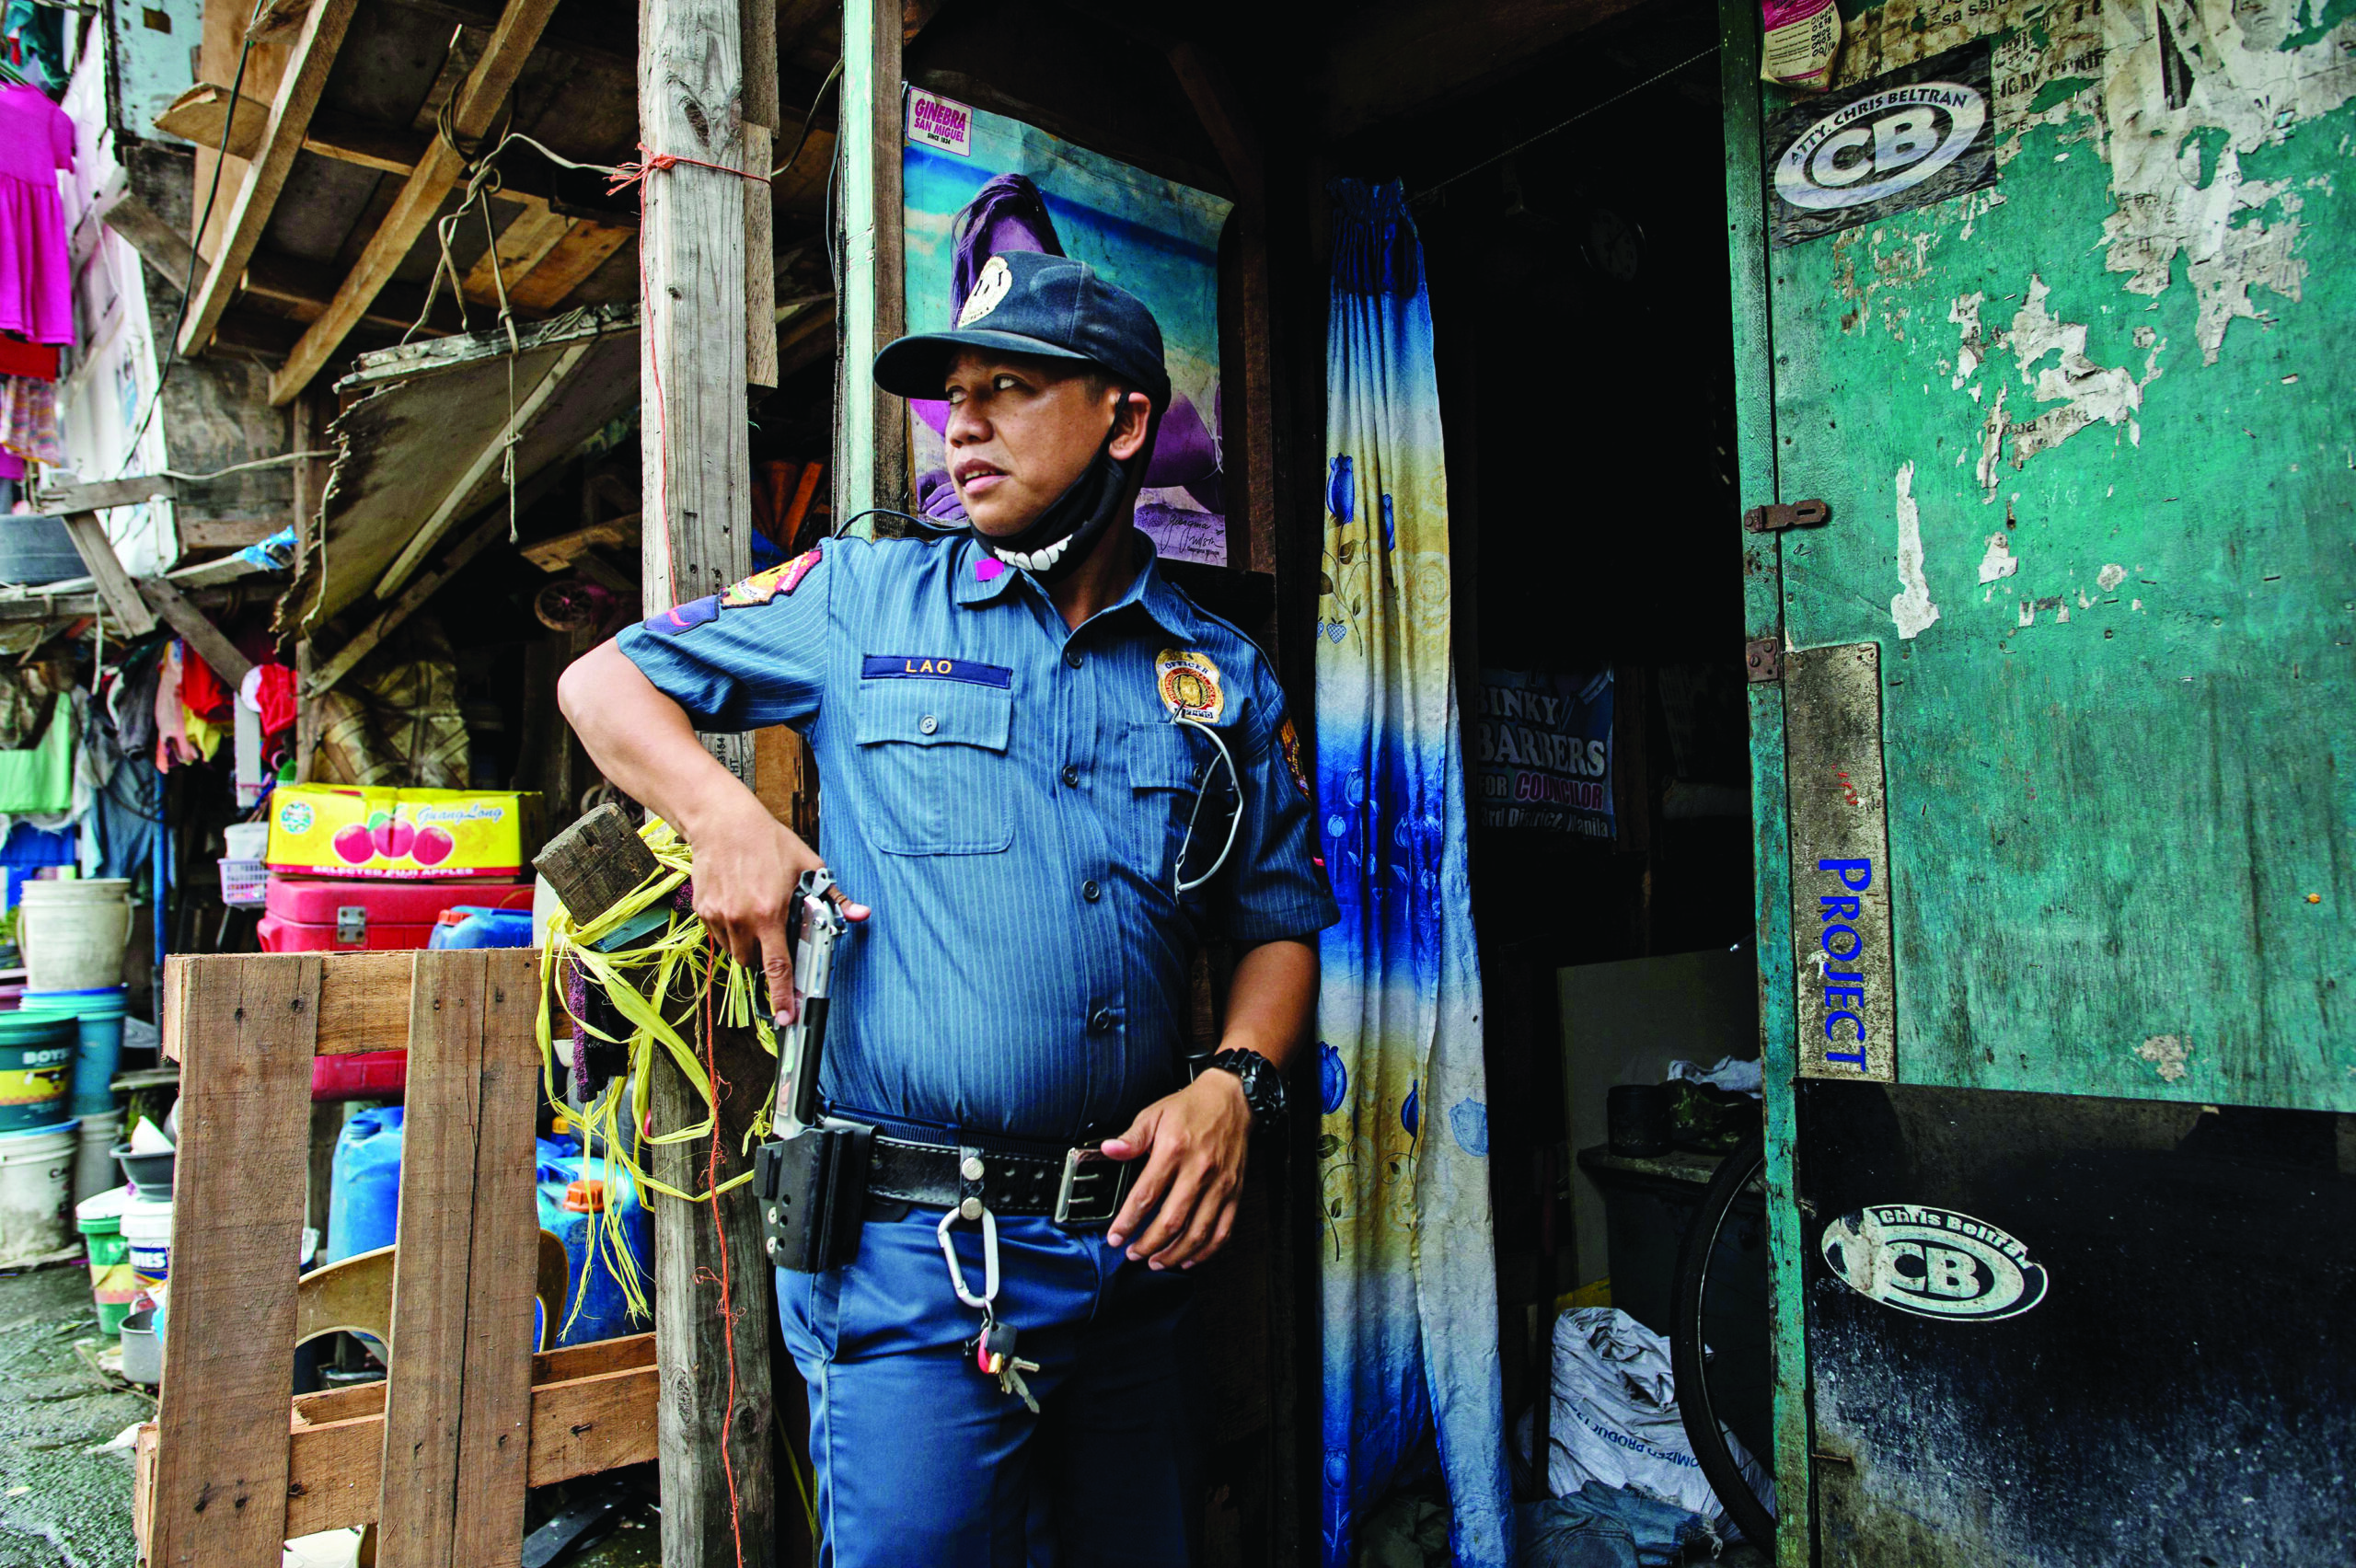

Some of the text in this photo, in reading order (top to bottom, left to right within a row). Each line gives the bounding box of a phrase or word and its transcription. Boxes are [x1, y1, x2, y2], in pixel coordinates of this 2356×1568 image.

[914, 98, 967, 132] GINEBRA
[914, 117, 964, 143] SAN MIGUEL
[1790, 88, 1968, 166] ATTY. CHRIS BELTRAN
[927, 133, 951, 144] SINCE 1834
[1812, 106, 1939, 187] CB
[906, 659, 953, 674] LAO
[1165, 661, 1208, 674] OFFICER
[1477, 722, 1605, 778] BARBERS
[1478, 769, 1604, 812] FOR COUNCILOR
[1481, 806, 1505, 828] 3rd
[313, 866, 382, 876] SELECTED
[386, 869, 418, 877] FUJI
[1819, 858, 1872, 1073] PROJECT
[1879, 1210, 1942, 1227] Chris
[1884, 1242, 1980, 1298] CB
